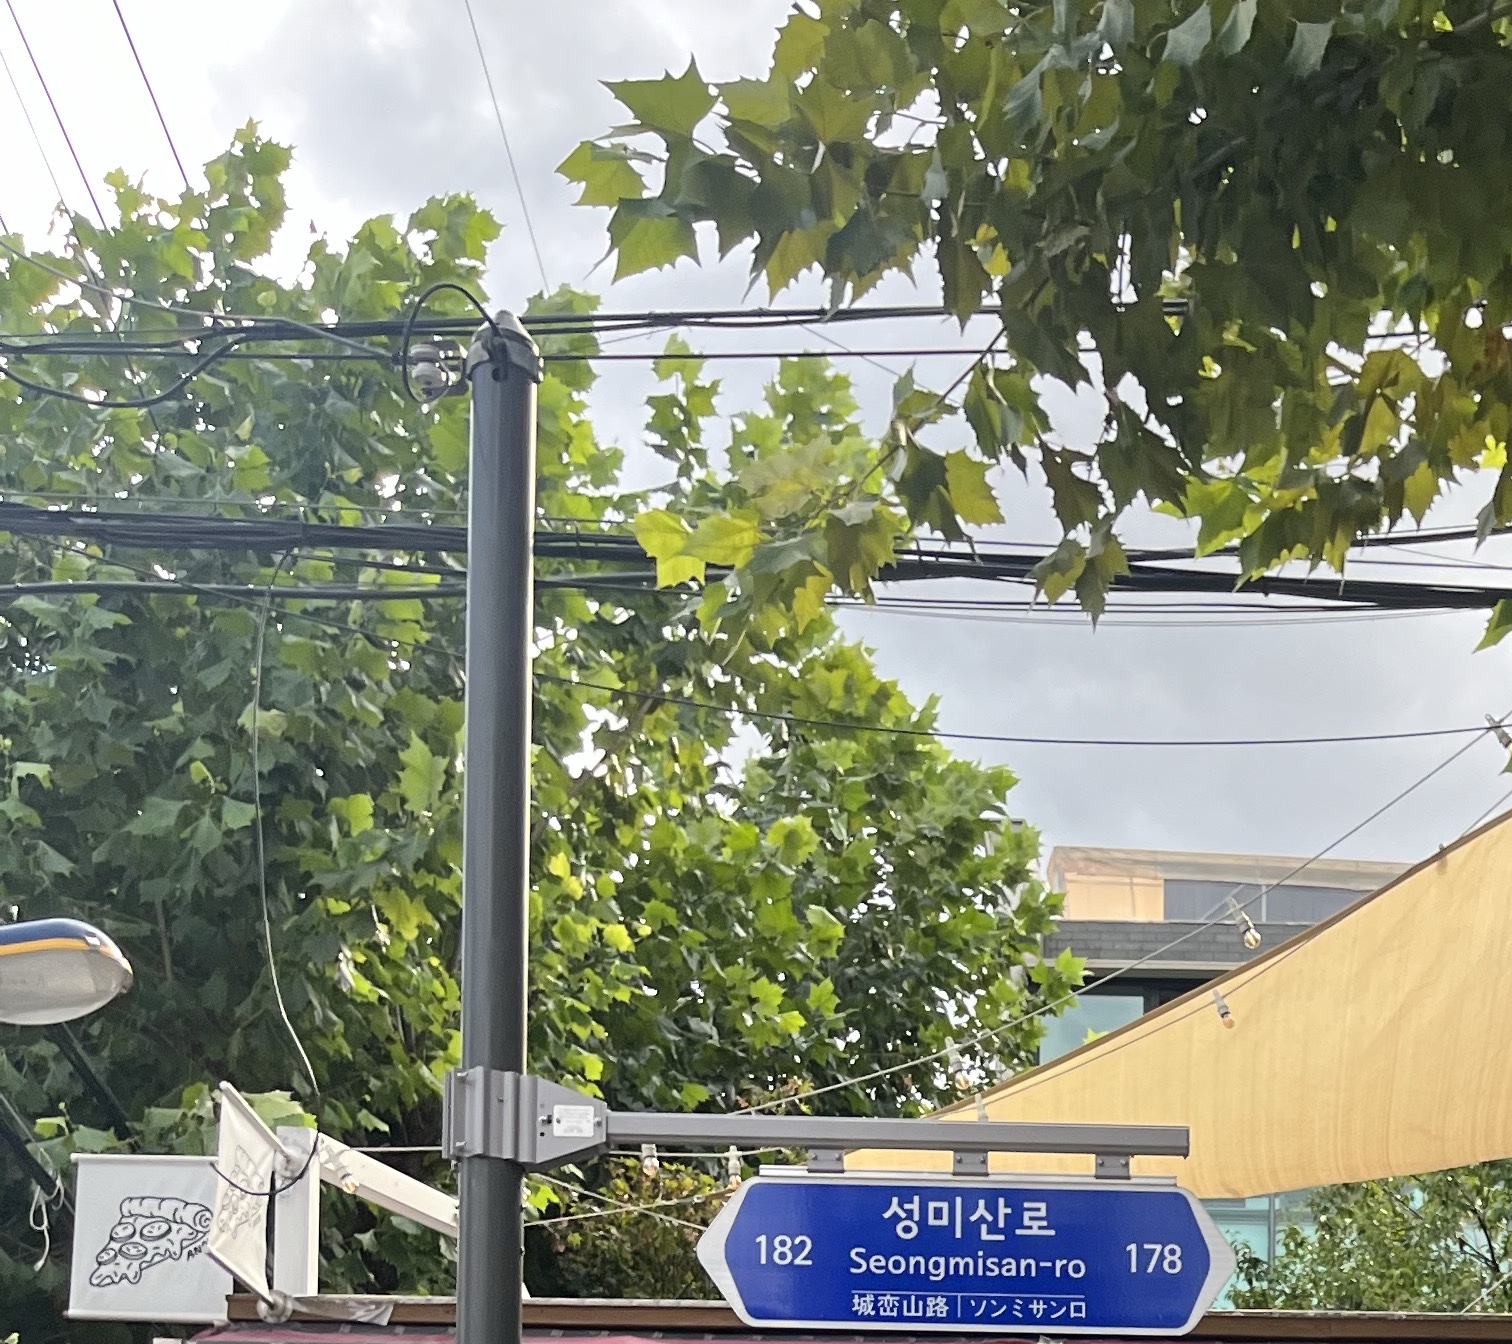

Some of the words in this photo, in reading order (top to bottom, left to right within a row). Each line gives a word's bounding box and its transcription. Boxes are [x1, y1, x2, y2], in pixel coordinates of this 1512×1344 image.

[882, 1194, 1057, 1241] 성미산로
[755, 1234, 813, 1266] 182
[849, 1247, 1087, 1281] Seongmisan-ro
[1125, 1243, 1183, 1274] 178
